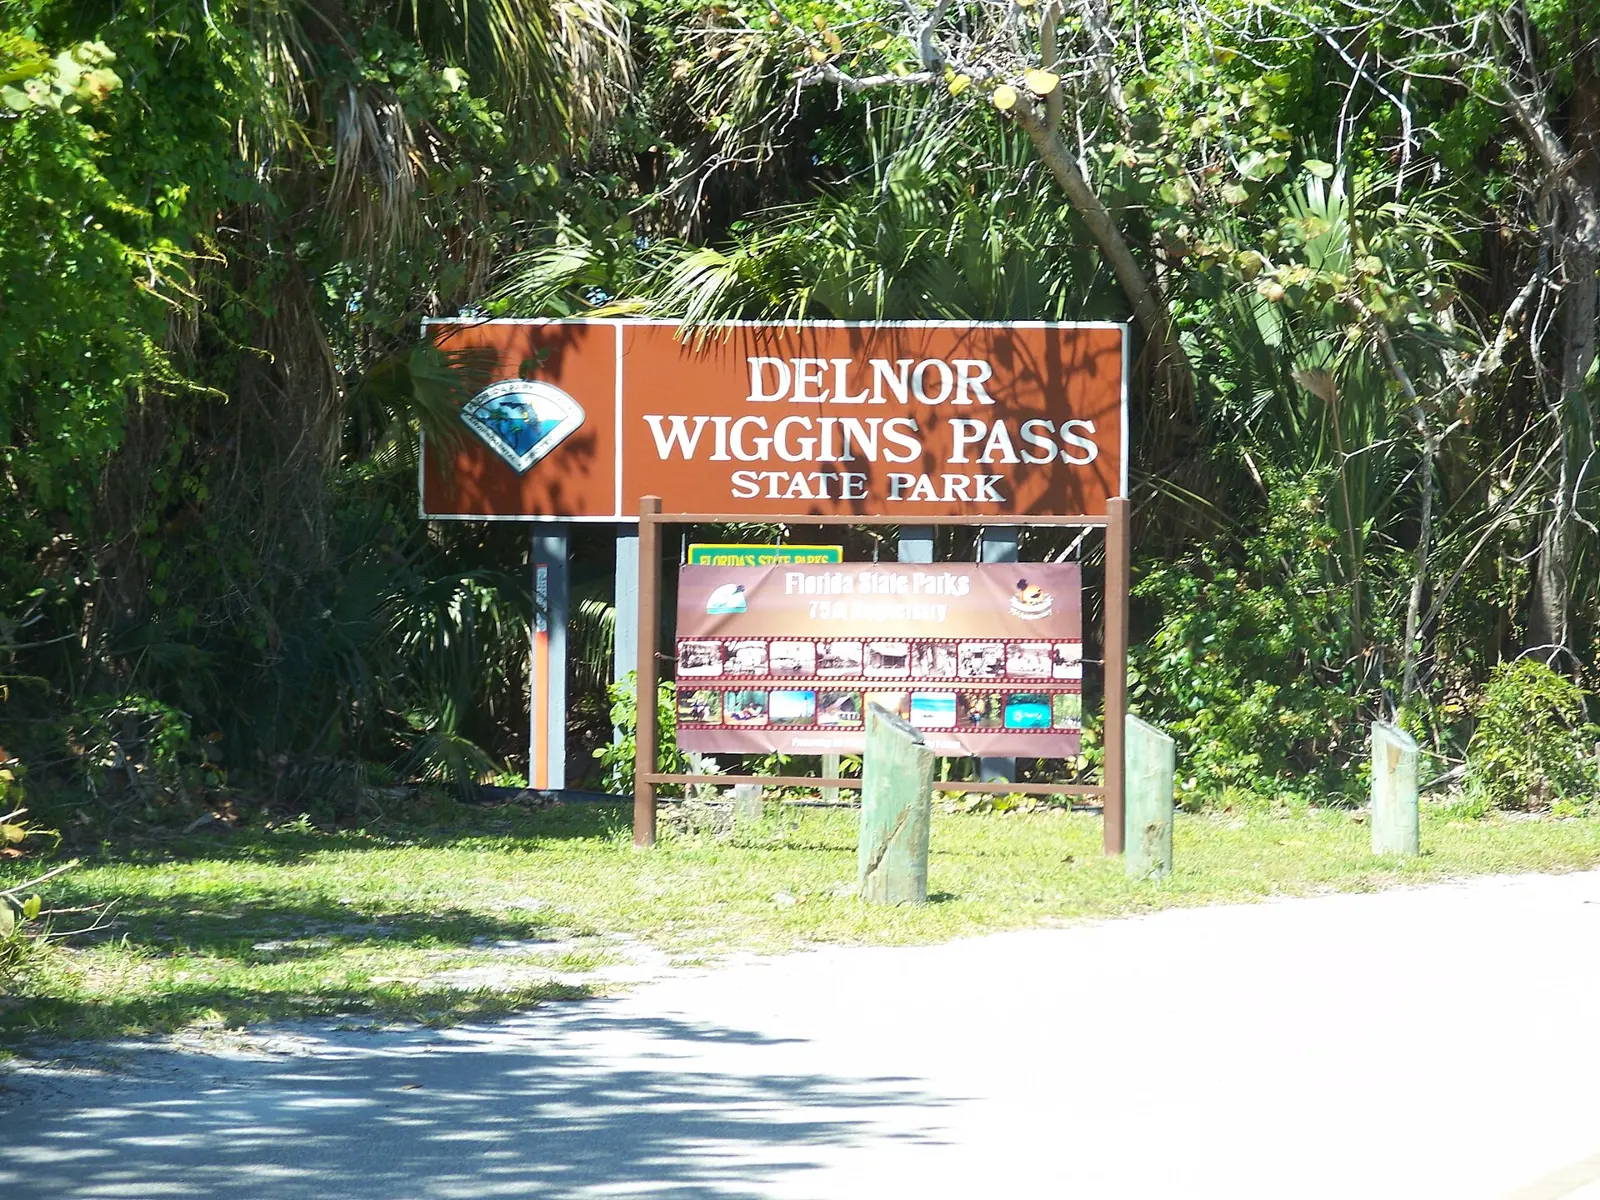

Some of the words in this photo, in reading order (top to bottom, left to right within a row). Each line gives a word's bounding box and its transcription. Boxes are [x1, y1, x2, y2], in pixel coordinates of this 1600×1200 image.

[745, 354, 996, 408] DELNOR
[642, 412, 924, 466] WIGGINS
[945, 417, 1100, 468] PASS
[730, 468, 870, 501] STATE
[885, 470, 1007, 505] PARK
[785, 572, 854, 595] Florida
[858, 571, 908, 595] State
[912, 572, 970, 596] Parks
